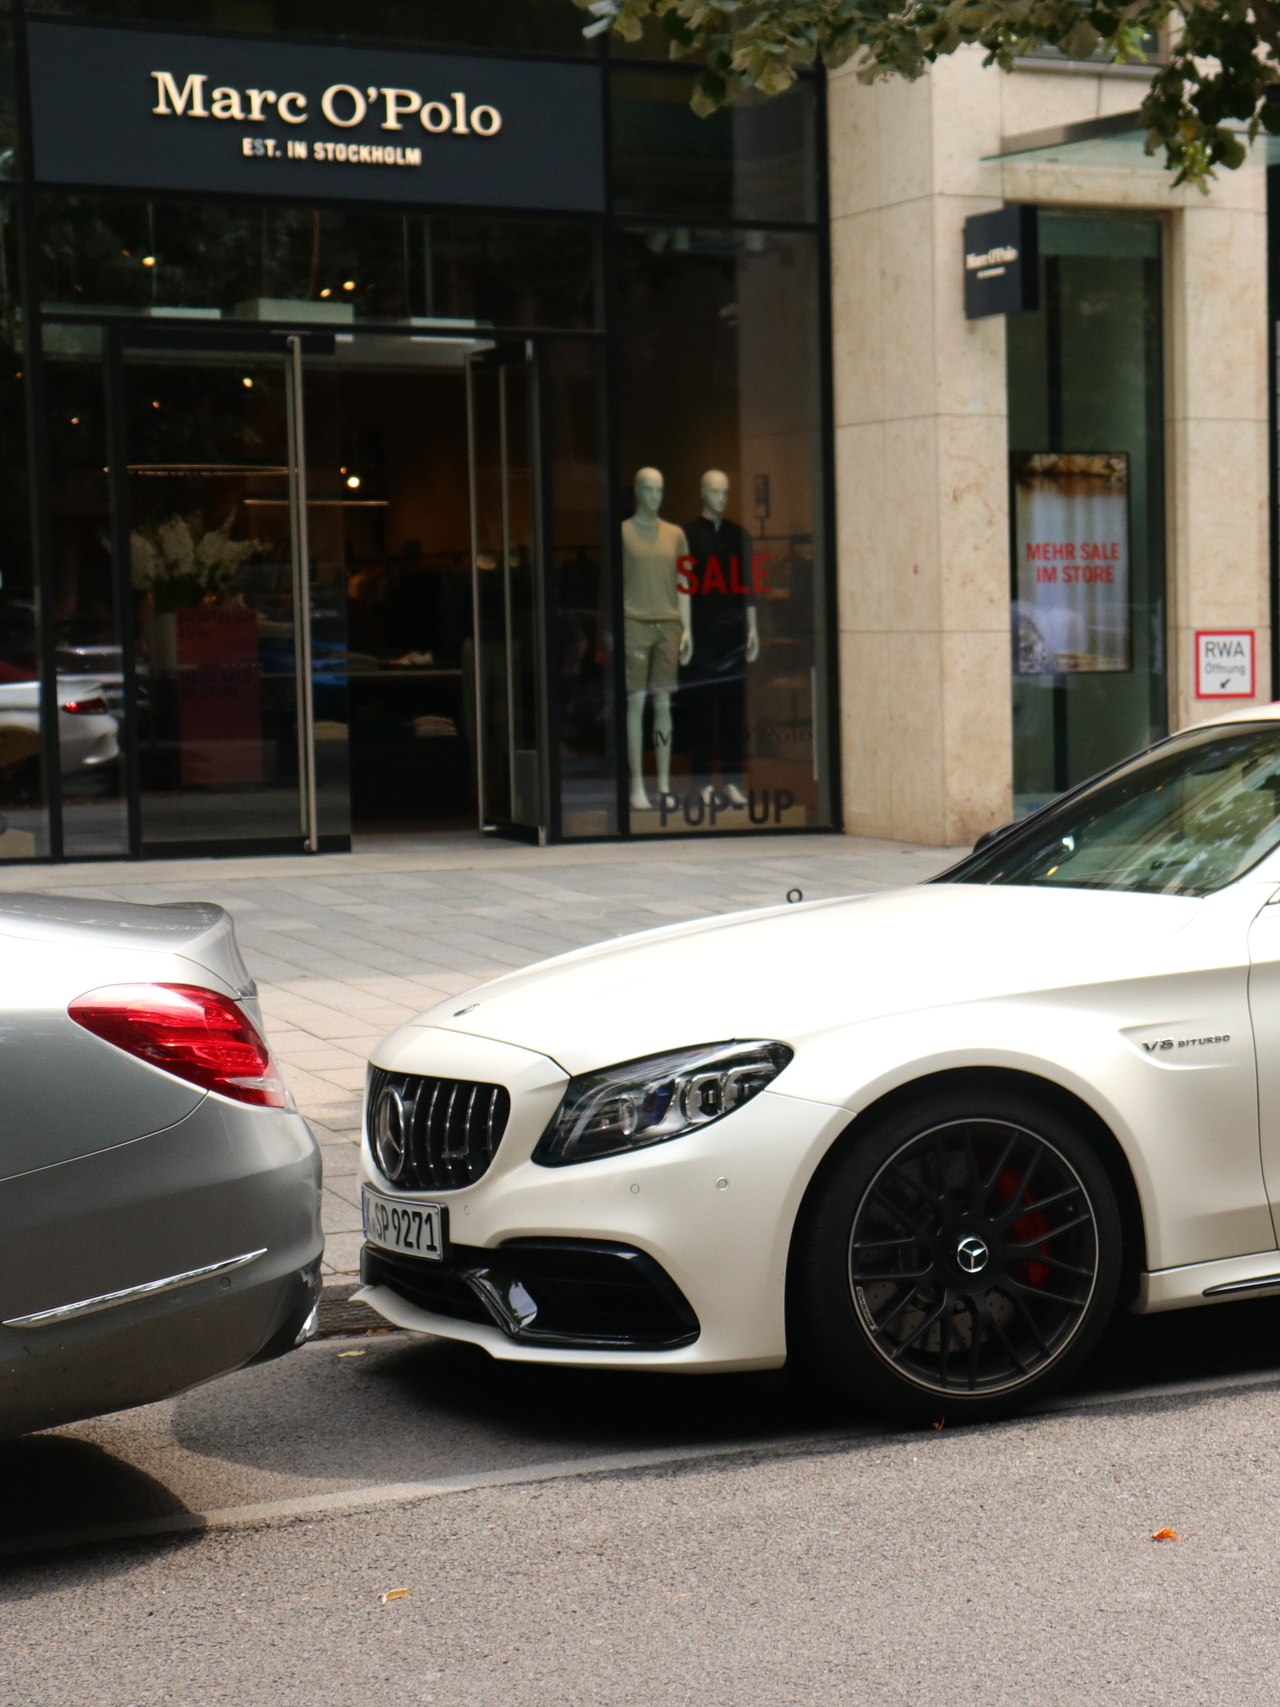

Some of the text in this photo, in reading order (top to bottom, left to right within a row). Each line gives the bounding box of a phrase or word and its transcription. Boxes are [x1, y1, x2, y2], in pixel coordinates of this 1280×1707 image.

[151, 71, 502, 136] Marc O'Polo
[242, 137, 422, 166] EST. IN STOCKHOLM
[1025, 542, 1119, 560] MEHR SALE
[675, 554, 773, 595] SALE
[1036, 565, 1114, 583] IM STORE
[1204, 640, 1245, 657] RWA
[1204, 661, 1245, 676] Öffnung
[660, 789, 794, 828] POP-UP
[1142, 1034, 1231, 1052] V8 BITURBO
[391, 1207, 437, 1252] 9271
